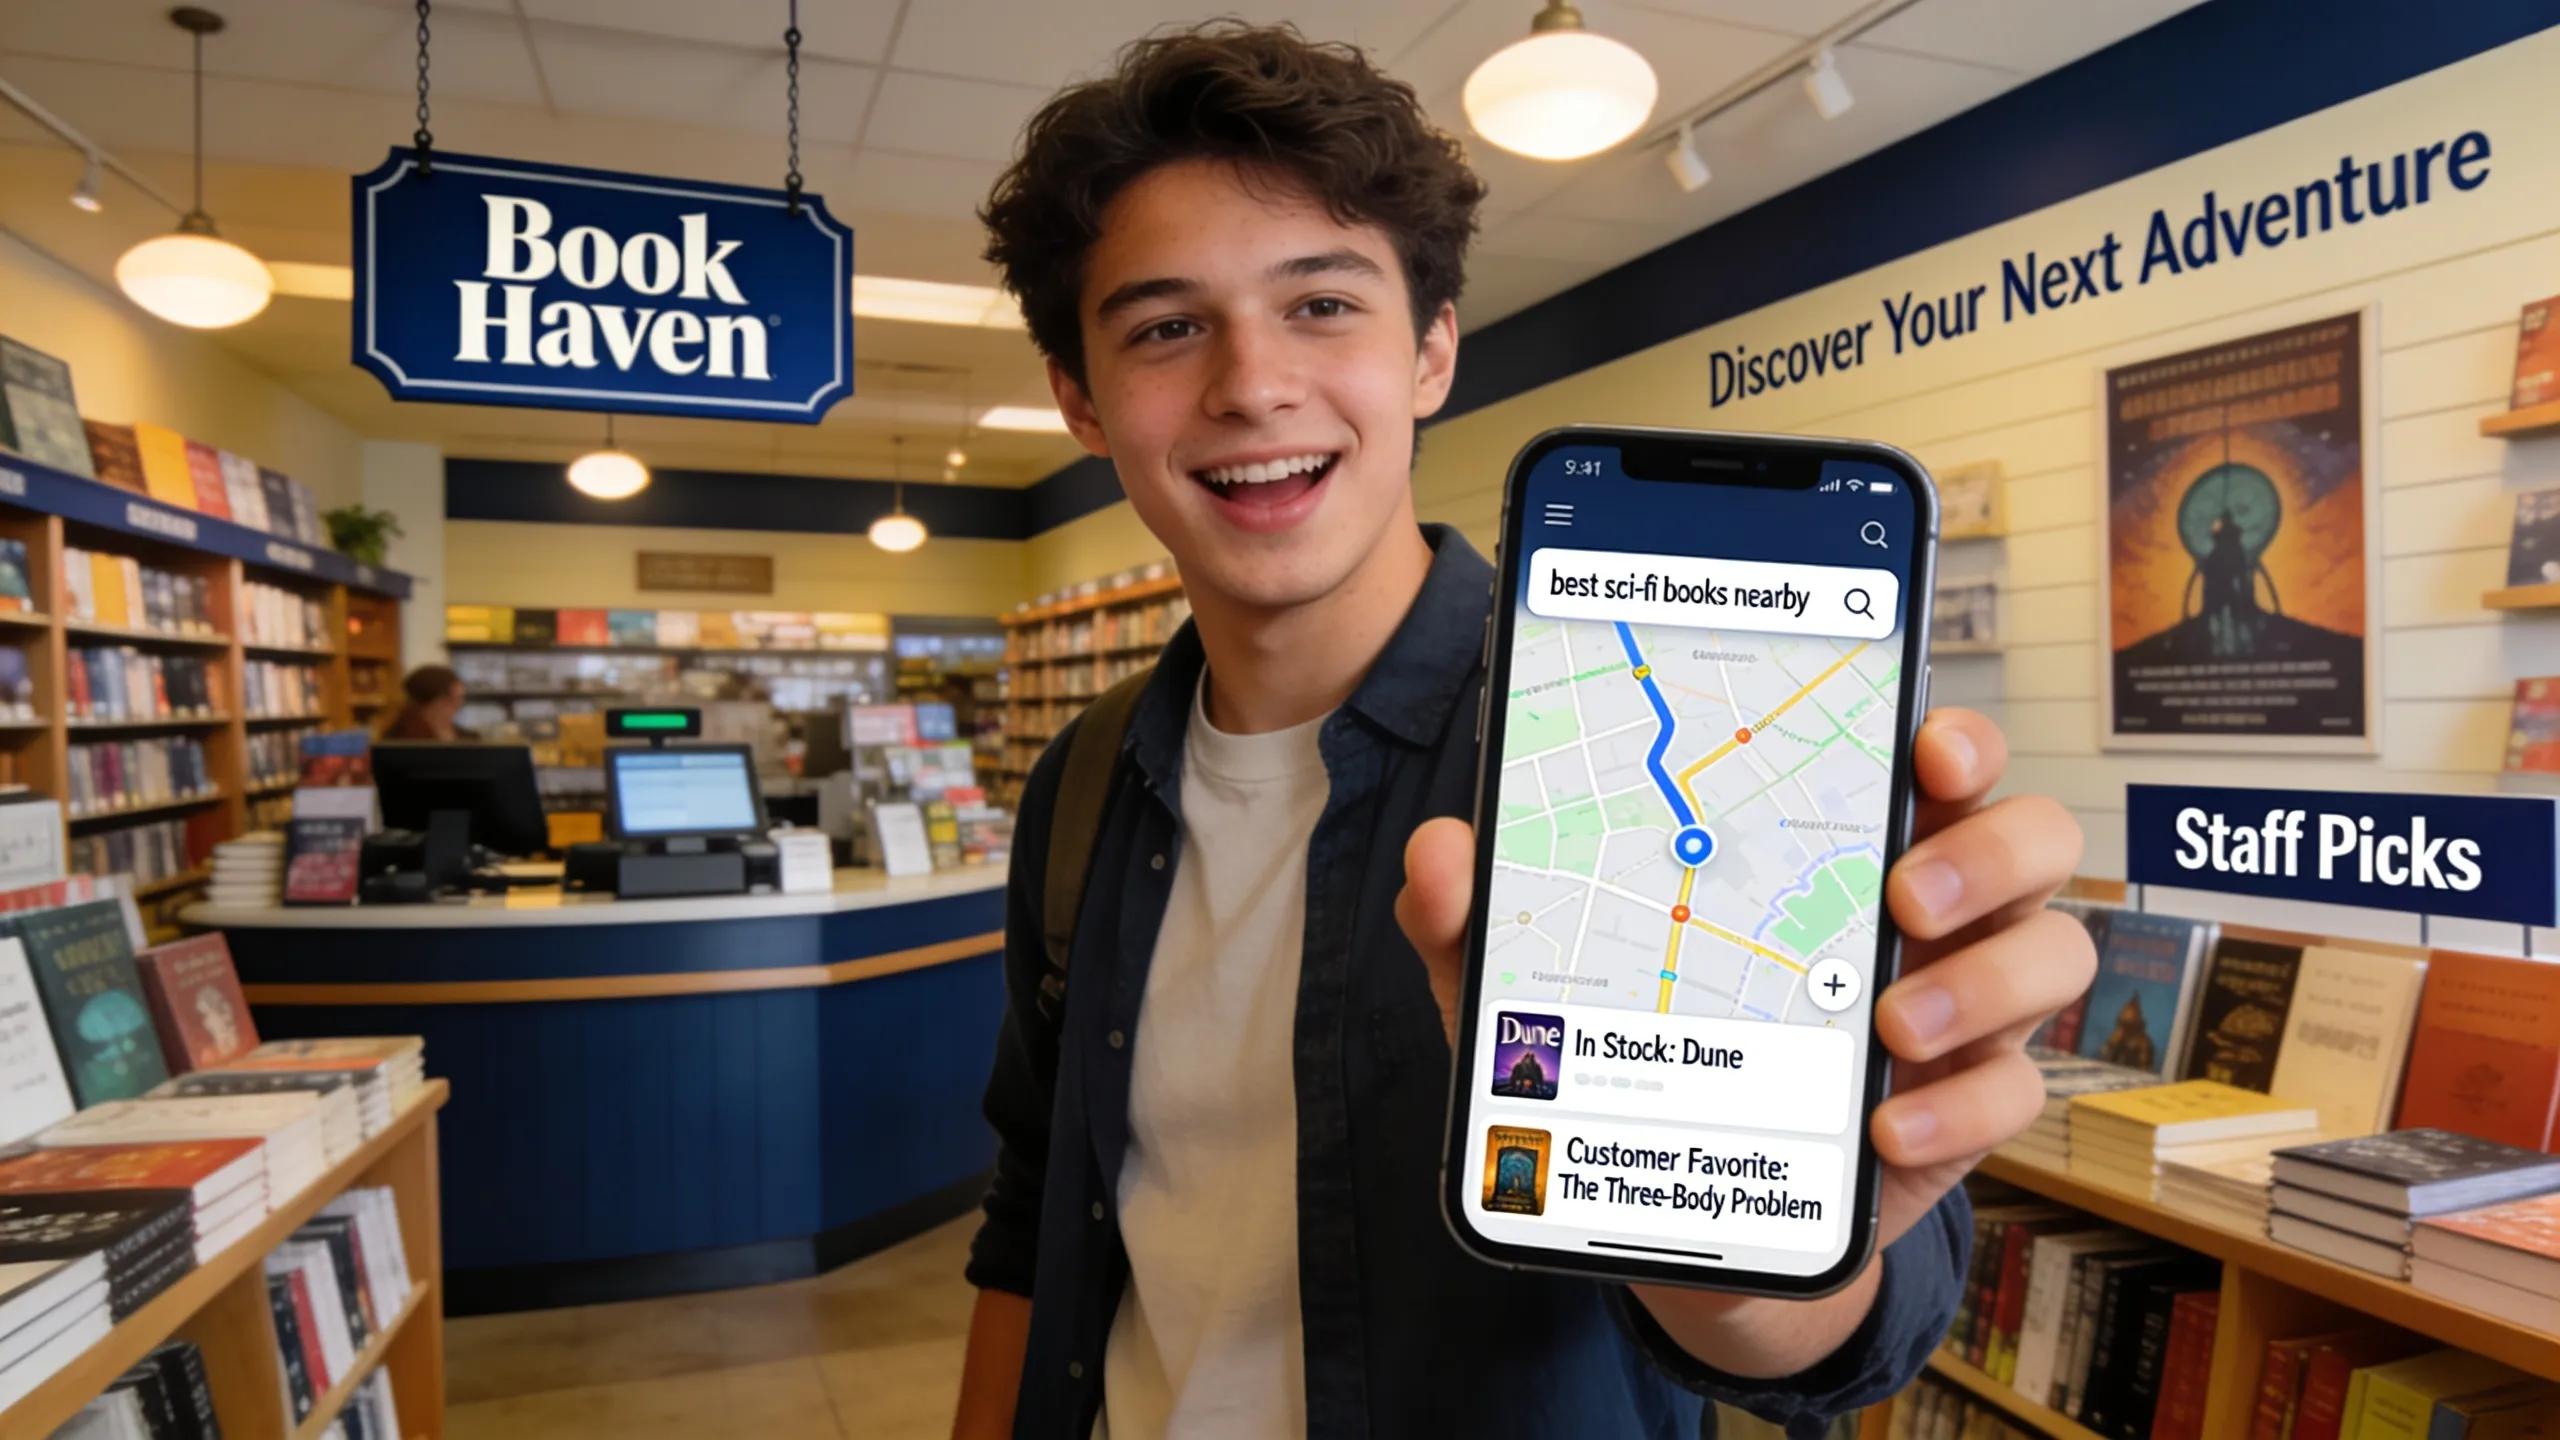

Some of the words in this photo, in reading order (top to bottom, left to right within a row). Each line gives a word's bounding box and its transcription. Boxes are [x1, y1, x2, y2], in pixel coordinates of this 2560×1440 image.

[480, 193, 750, 305] Book
[1709, 321, 1873, 409] Discover
[1882, 290, 1987, 355] Your
[2002, 232, 2123, 323] Next
[2138, 130, 2493, 285] Adventure
[453, 280, 772, 381] Haven
[1550, 567, 1599, 598] best
[1604, 572, 1660, 602] sci-fi
[1663, 575, 1729, 607] books
[1734, 581, 1811, 619] nearby
[2174, 807, 2306, 877] Staff
[2318, 813, 2483, 892] Picks
[1501, 1016, 1562, 1048] Dune
[1574, 1028, 1596, 1058] In
[1602, 1031, 1677, 1064] Stock:
[1681, 1037, 1745, 1070] Dune
[1566, 1136, 1682, 1173] Customer
[1687, 1147, 1790, 1181] Favorite:
[1557, 1173, 1600, 1201] The
[1603, 1176, 1727, 1220] Three-Body
[1731, 1187, 1823, 1221] Problem
